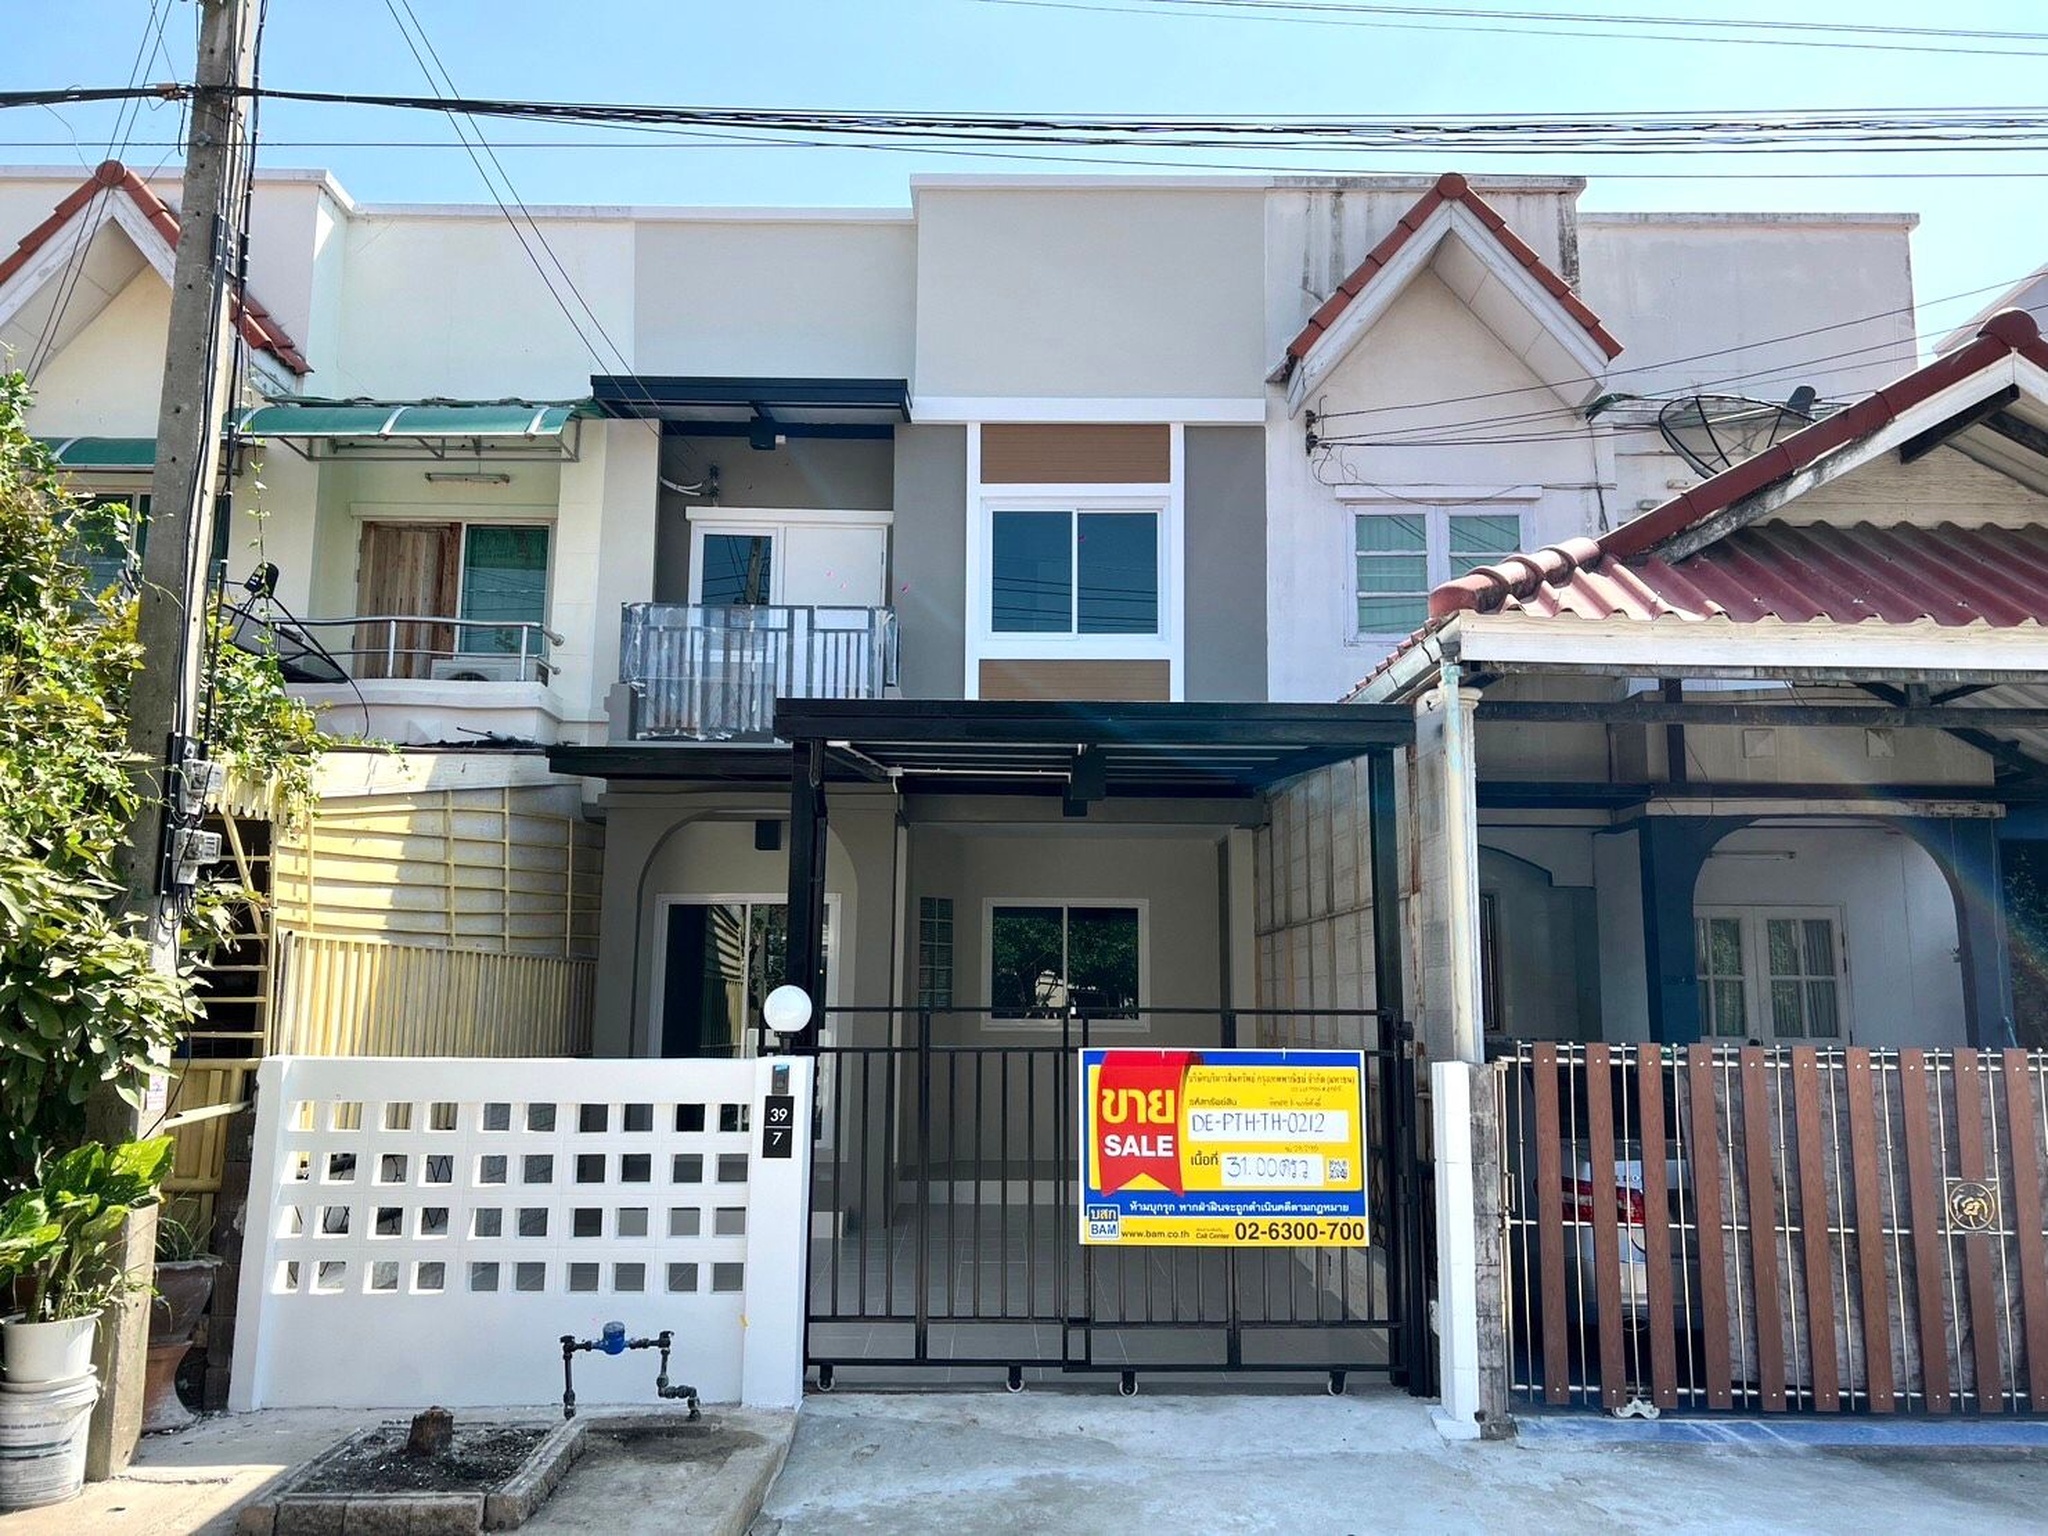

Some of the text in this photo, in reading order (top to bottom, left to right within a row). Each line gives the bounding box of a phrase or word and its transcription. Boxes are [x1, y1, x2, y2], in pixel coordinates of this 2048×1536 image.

[1102, 1088, 1175, 1124] ขาย
[770, 1108, 788, 1122] 39
[1192, 1112, 1325, 1134] DE-PTH-TH-0212
[772, 1132, 783, 1146] 7
[1104, 1134, 1175, 1157] SALE
[1190, 1150, 1219, 1166] เนื้อที่
[1090, 1209, 1117, 1220] บสก
[1130, 1201, 1175, 1215] ห้ามบุกรุก
[1090, 1224, 1117, 1235] BAM
[1121, 1230, 1190, 1239] www.bam.co.th
[1235, 1222, 1364, 1240] 02-6300-700
